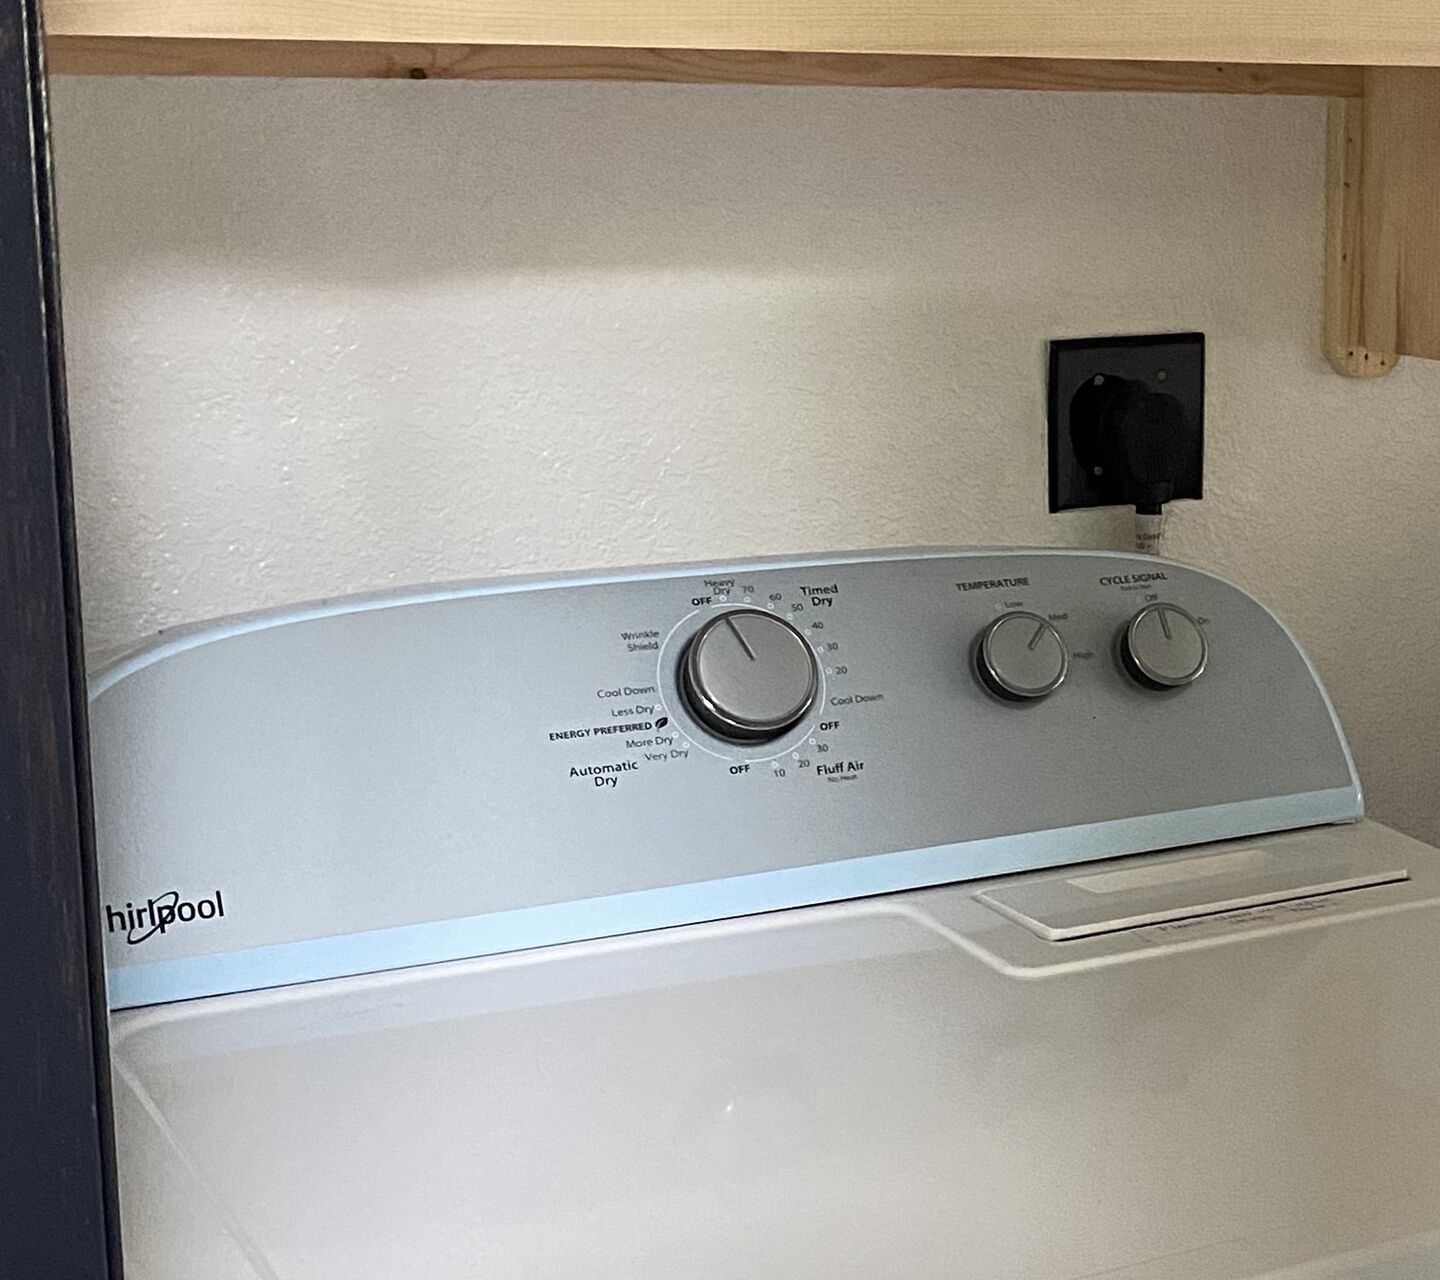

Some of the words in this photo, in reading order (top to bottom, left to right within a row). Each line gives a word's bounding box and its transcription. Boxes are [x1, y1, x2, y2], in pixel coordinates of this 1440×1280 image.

[955, 577, 1031, 592] TEMPERATURE
[1100, 575, 1132, 586] CYCLE
[1132, 572, 1168, 583] SIGNAL
[713, 587, 731, 596] Dry
[743, 585, 754, 593] 70
[800, 584, 838, 596] Timed
[691, 596, 712, 606] OFF
[769, 592, 782, 601] 60
[812, 596, 833, 607] Dry
[791, 603, 804, 612] 50
[621, 630, 660, 641] Wrinkle
[627, 642, 659, 652] Shield
[827, 643, 839, 651] 30
[835, 666, 848, 675] 20
[597, 687, 622, 699] Cool
[623, 686, 655, 696] Down
[830, 696, 854, 706] Cool
[854, 694, 884, 704] Down
[611, 708, 634, 717] Less
[636, 705, 655, 715] Dry
[549, 728, 591, 741] ENERGY
[594, 721, 652, 736] PREFERRED
[820, 721, 840, 731] OFF
[626, 737, 653, 748] More
[655, 735, 674, 745] Dry
[817, 744, 829, 753] 30
[644, 751, 668, 761] Very
[670, 749, 689, 758] Dry
[569, 760, 639, 777] Automatic
[729, 764, 751, 775] OFF
[799, 760, 810, 768] 20
[816, 762, 844, 776] Fluff
[847, 761, 865, 772] Air
[774, 769, 786, 777] 10
[594, 776, 618, 788] Dry
[105, 890, 225, 945] hirlpool
